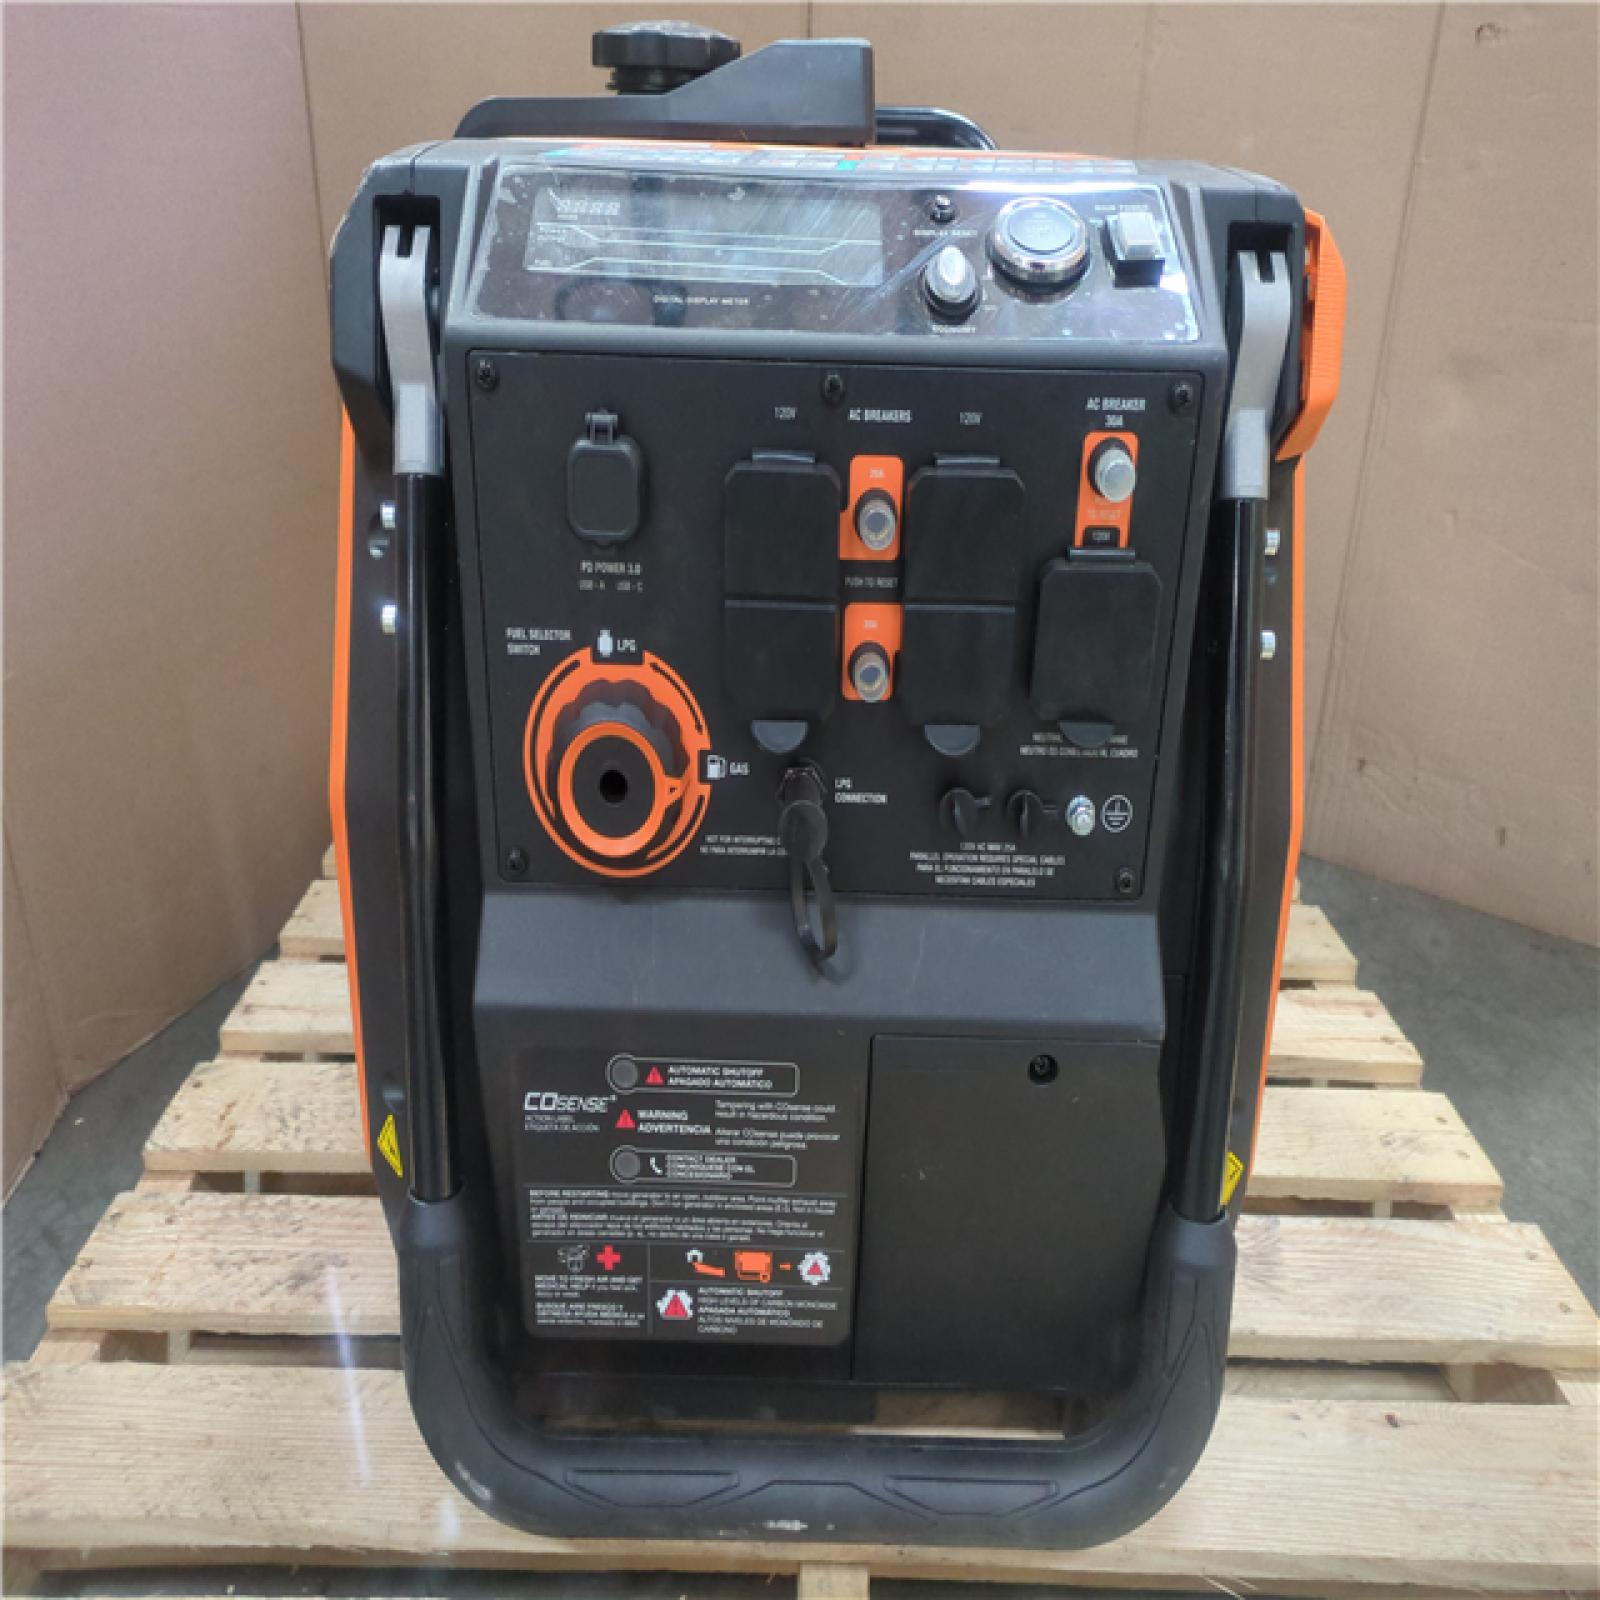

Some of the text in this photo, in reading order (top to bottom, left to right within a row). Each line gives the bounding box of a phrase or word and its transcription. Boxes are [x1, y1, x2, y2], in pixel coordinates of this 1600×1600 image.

[1086, 397, 1145, 411] AC BREAKER
[849, 408, 912, 422] AC BREAKERS
[617, 638, 636, 652] LPG
[730, 762, 750, 775] GAS
